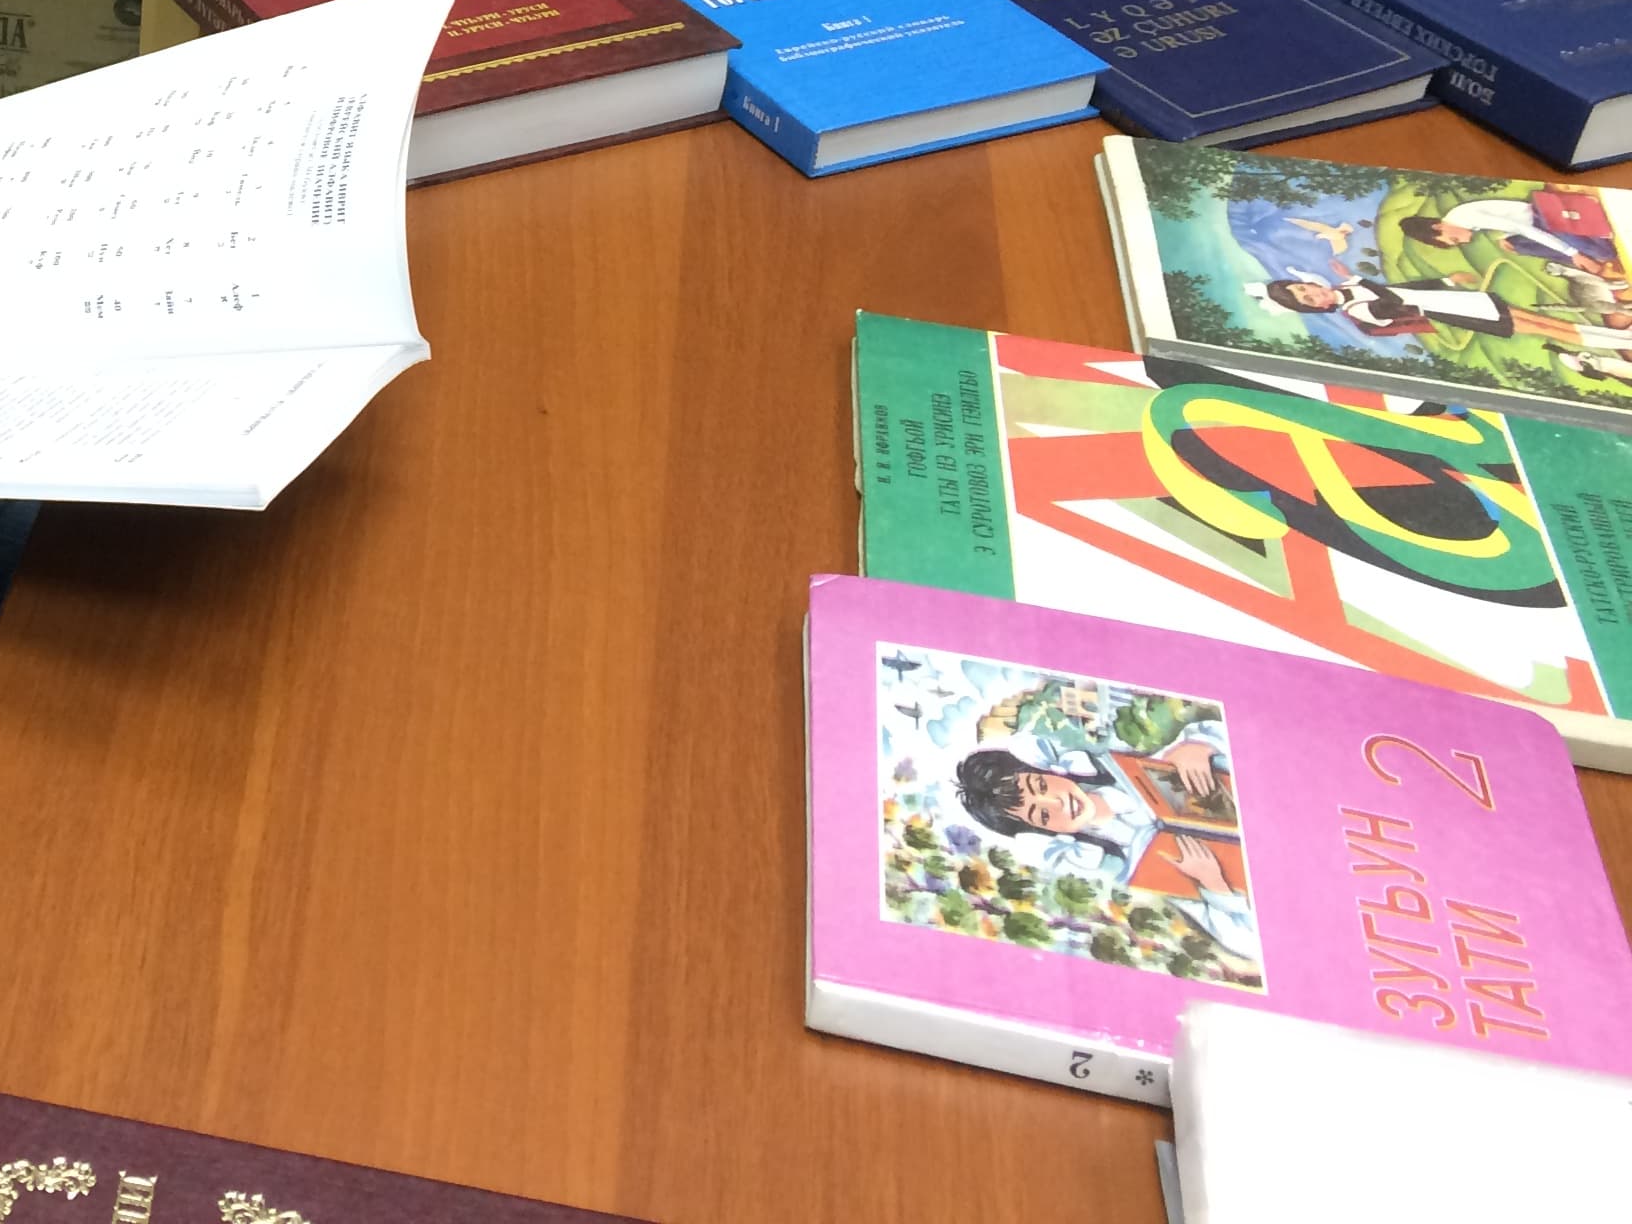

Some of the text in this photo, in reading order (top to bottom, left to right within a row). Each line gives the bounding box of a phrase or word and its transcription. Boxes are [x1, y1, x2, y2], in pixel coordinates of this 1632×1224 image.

[821, 18, 863, 32] Книга
[742, 95, 771, 125] Книга
[337, 183, 347, 224] ИВРИТ
[938, 477, 961, 515] ТАТЫ
[1550, 503, 1619, 624] ТАТСКО-РУССКИЙ
[1338, 733, 1497, 1030] ЗУГЬУН 2
[1445, 897, 1551, 1041] ТАТИ
[1067, 1050, 1093, 1079] 2
